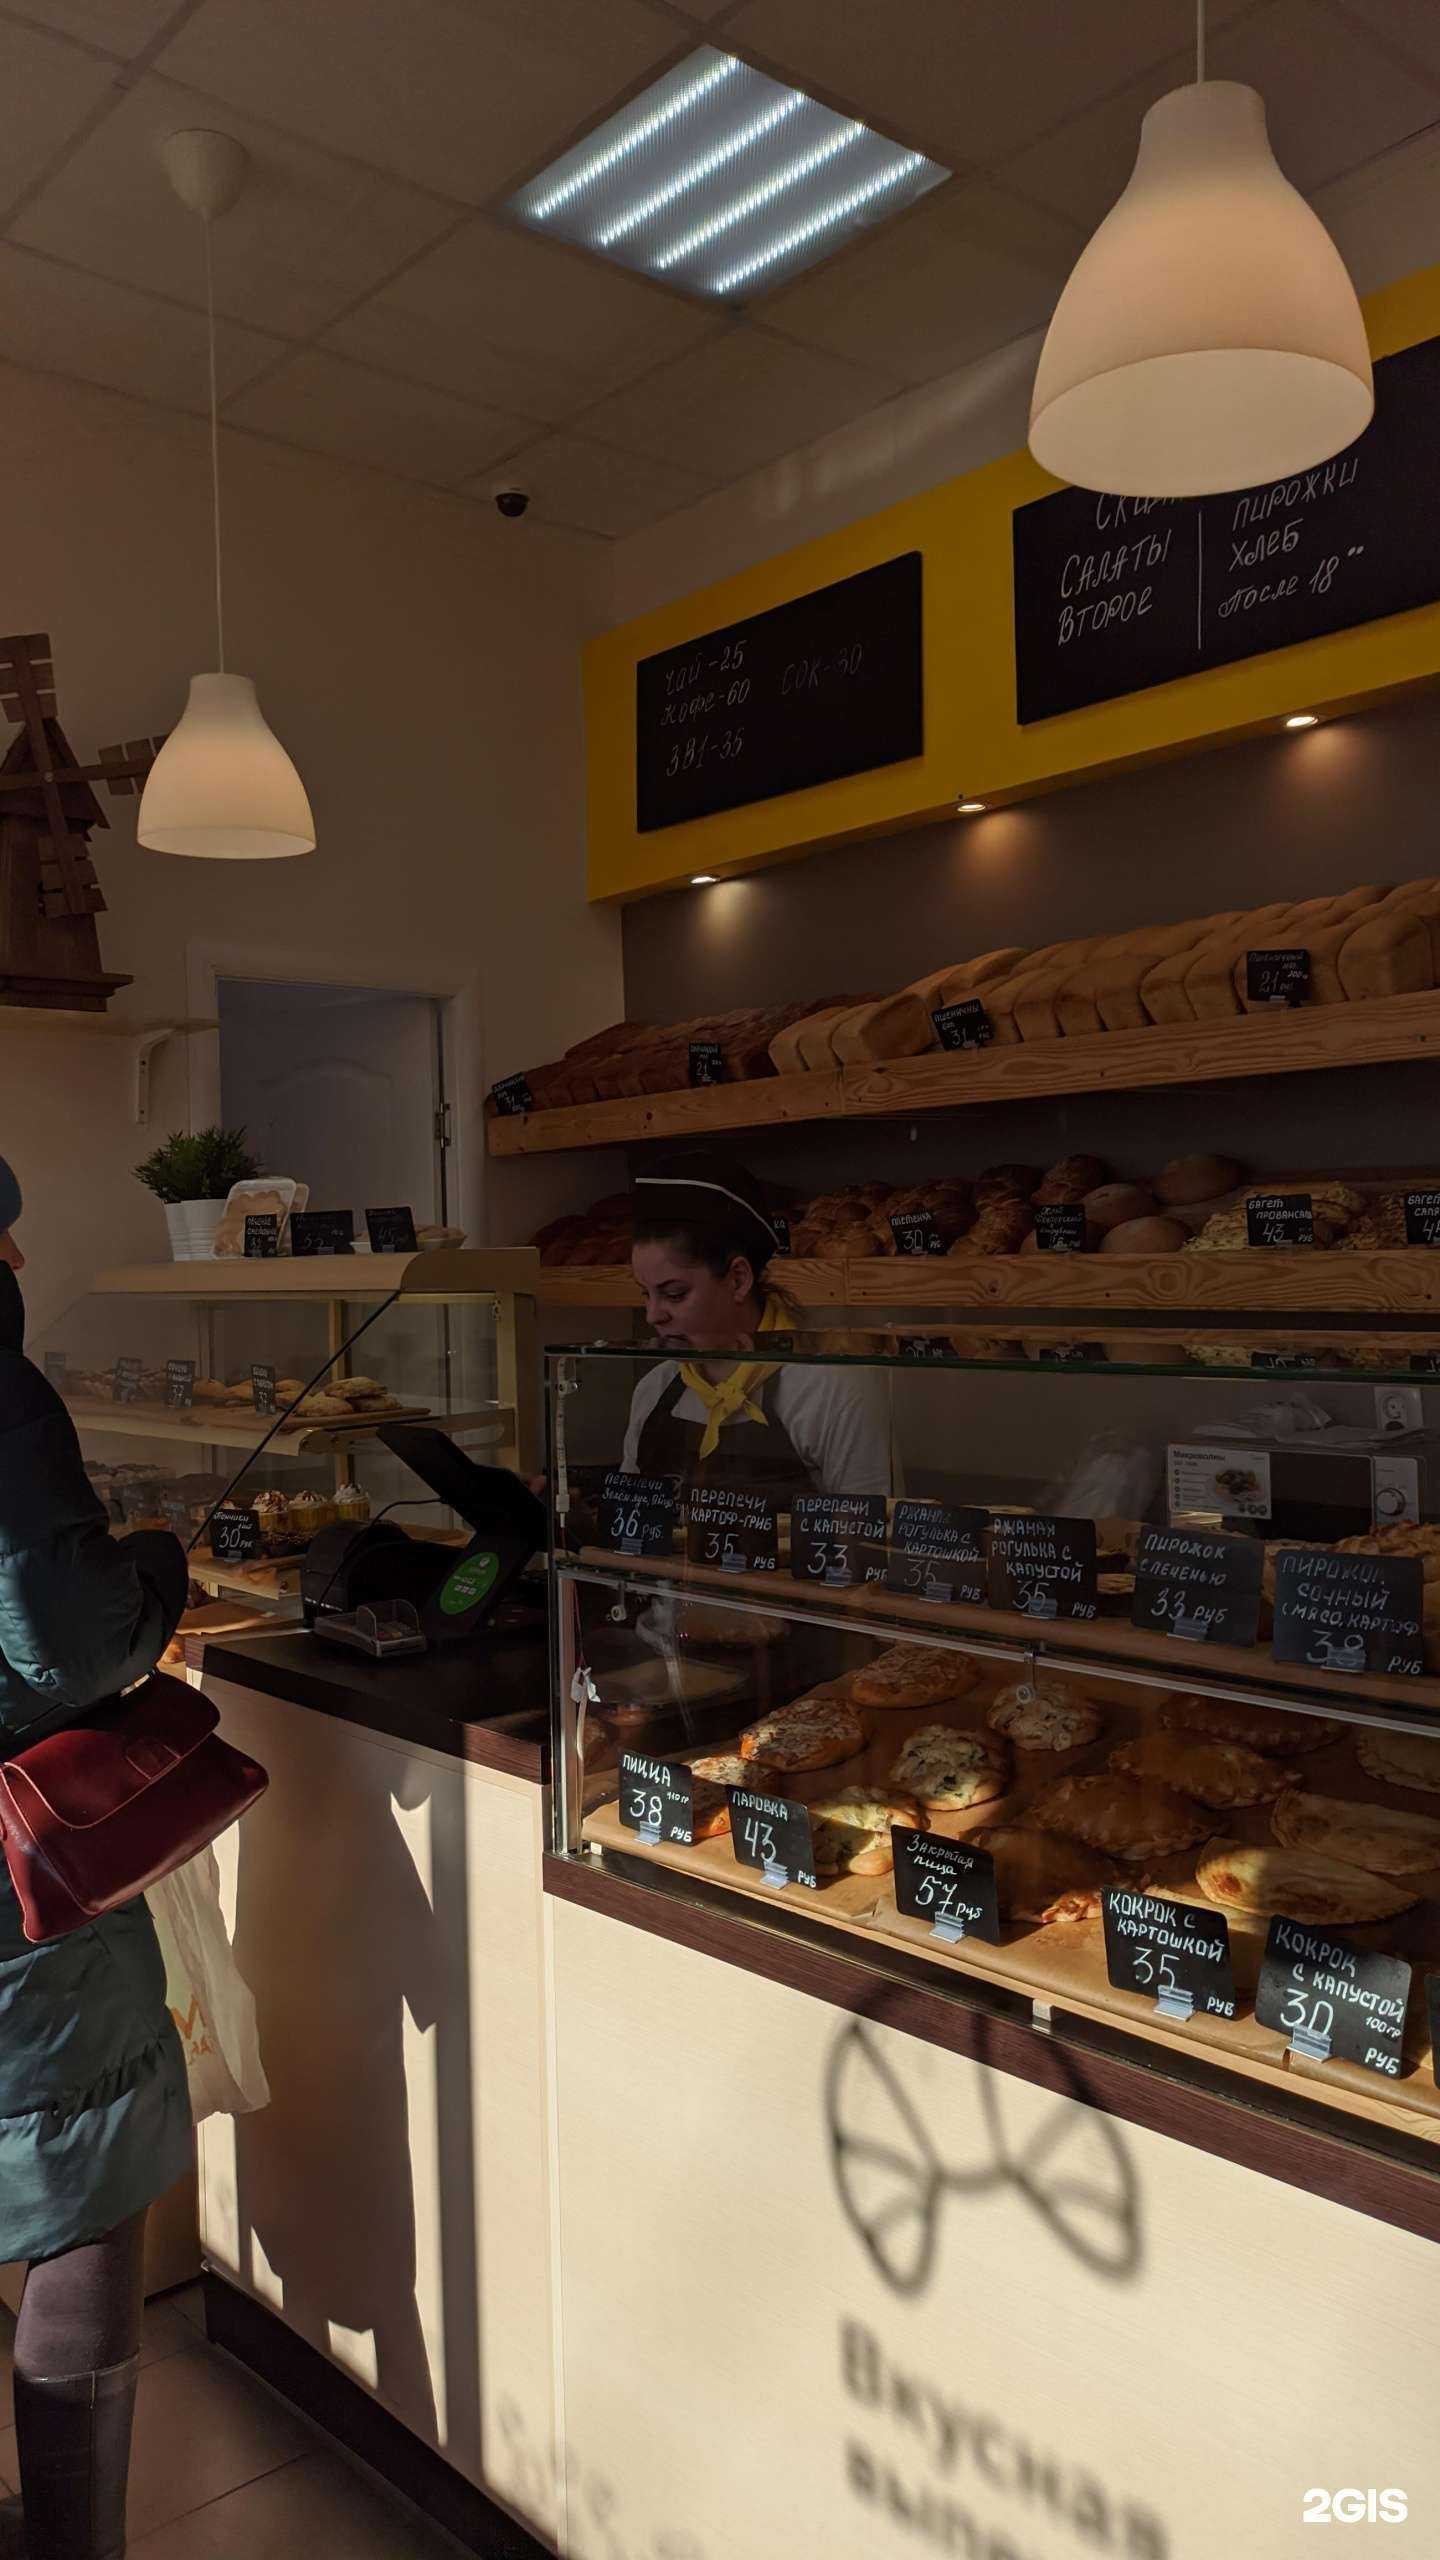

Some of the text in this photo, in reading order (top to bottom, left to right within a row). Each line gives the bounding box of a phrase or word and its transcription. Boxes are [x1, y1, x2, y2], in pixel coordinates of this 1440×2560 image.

[1232, 457, 1360, 532] ПИРОЖКИ
[1060, 529, 1173, 599] САЛАТЫ
[1057, 586, 1153, 647] ВТОРОЕ
[218, 1526, 241, 1549] 30
[611, 1503, 641, 1538] 36
[813, 1518, 885, 1539] КАПУСТОЙ
[704, 1532, 740, 1560] 35
[806, 1541, 849, 1575] 33
[904, 1542, 981, 1563] КАРТОШКОЙ
[991, 1539, 1057, 1559] РОГУЛЬКА
[1144, 1533, 1227, 1560] ПИРОЖОК
[1006, 1561, 1085, 1585] КАПУСТОЙ
[1012, 1579, 1050, 1611] 35
[1150, 1587, 1187, 1622] 33
[1297, 1582, 1391, 1611] СОЧНЫЙ
[622, 1753, 671, 1787] ПИЦЦА
[629, 1788, 663, 1827] 38
[732, 1790, 789, 1822] ПАРОВКА
[670, 1826, 693, 1843] РУБ
[744, 1816, 777, 1864] 43
[797, 1869, 817, 1888] РУБ
[914, 1875, 958, 1915] 57
[1109, 1892, 1178, 1928] КОКРОК
[1117, 1917, 1226, 1963] КАРТОШКОЙ
[1275, 1923, 1358, 1978] КОКРОК
[1132, 1946, 1181, 1990] 35
[1279, 1987, 1335, 2035] 30
[1312, 1969, 1406, 2024] КАПУСТОЙ
[1364, 2047, 1401, 2076] РУБ
